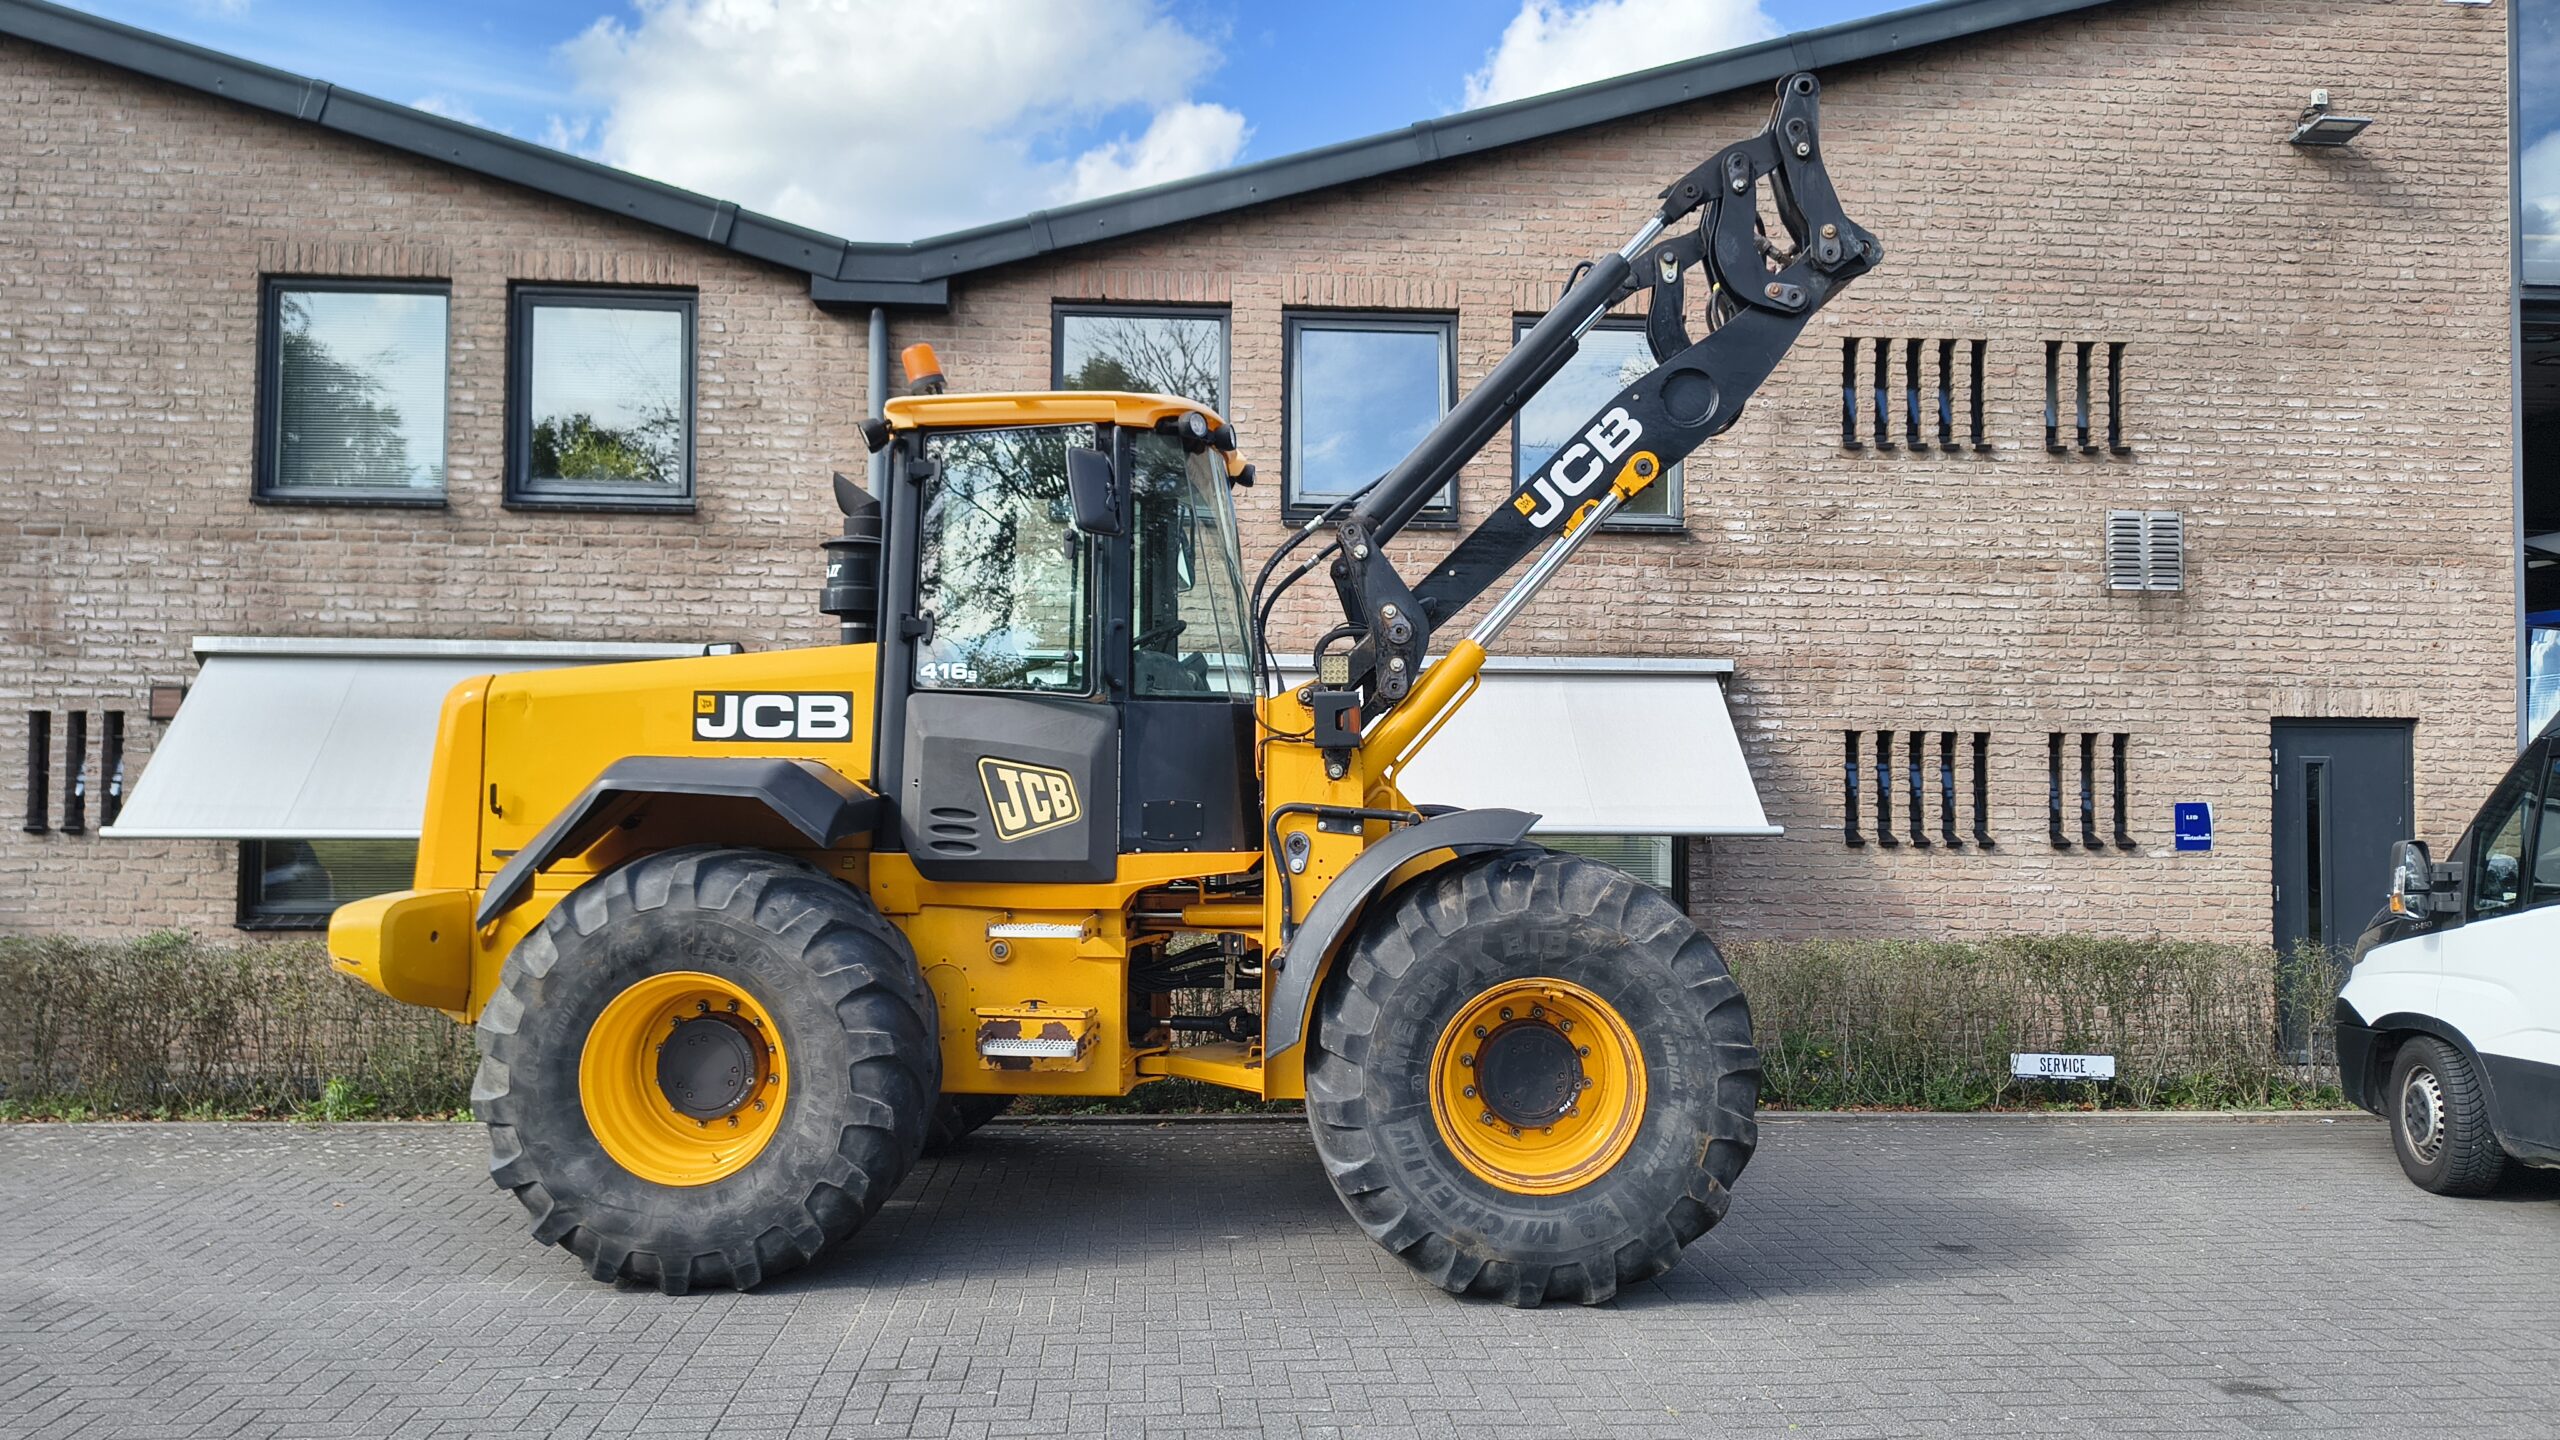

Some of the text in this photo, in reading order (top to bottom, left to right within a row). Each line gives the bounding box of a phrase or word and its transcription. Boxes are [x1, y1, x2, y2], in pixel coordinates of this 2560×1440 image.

[1528, 406, 1643, 528] JCB
[696, 695, 850, 739] JCB
[997, 767, 1075, 831] JCB
[2040, 1057, 2086, 1073] SERVICE
